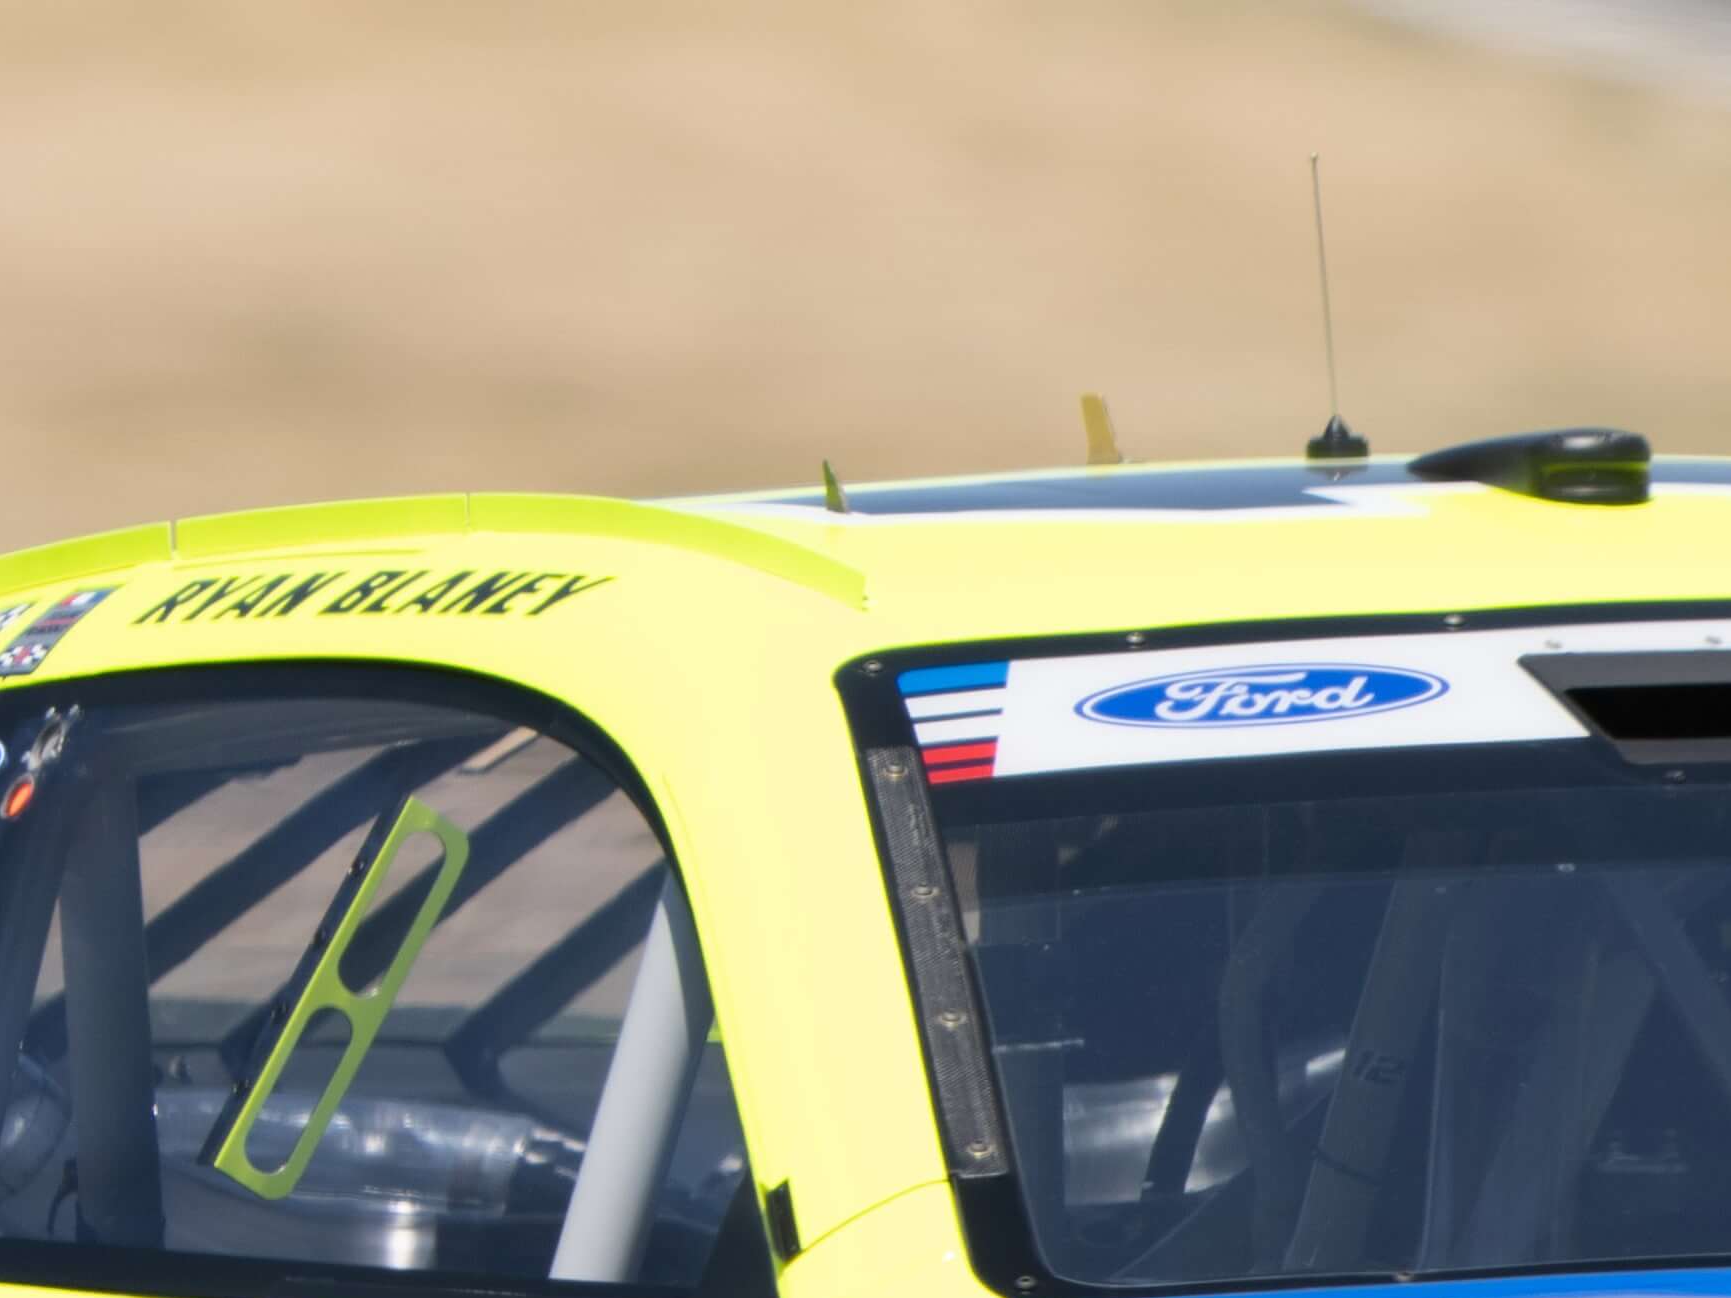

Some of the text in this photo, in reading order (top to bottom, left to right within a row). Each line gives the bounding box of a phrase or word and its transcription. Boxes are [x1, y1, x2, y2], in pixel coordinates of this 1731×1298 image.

[131, 570, 350, 626] RYAN
[317, 568, 616, 617] BLANEY
[1155, 671, 1376, 721] Ford
